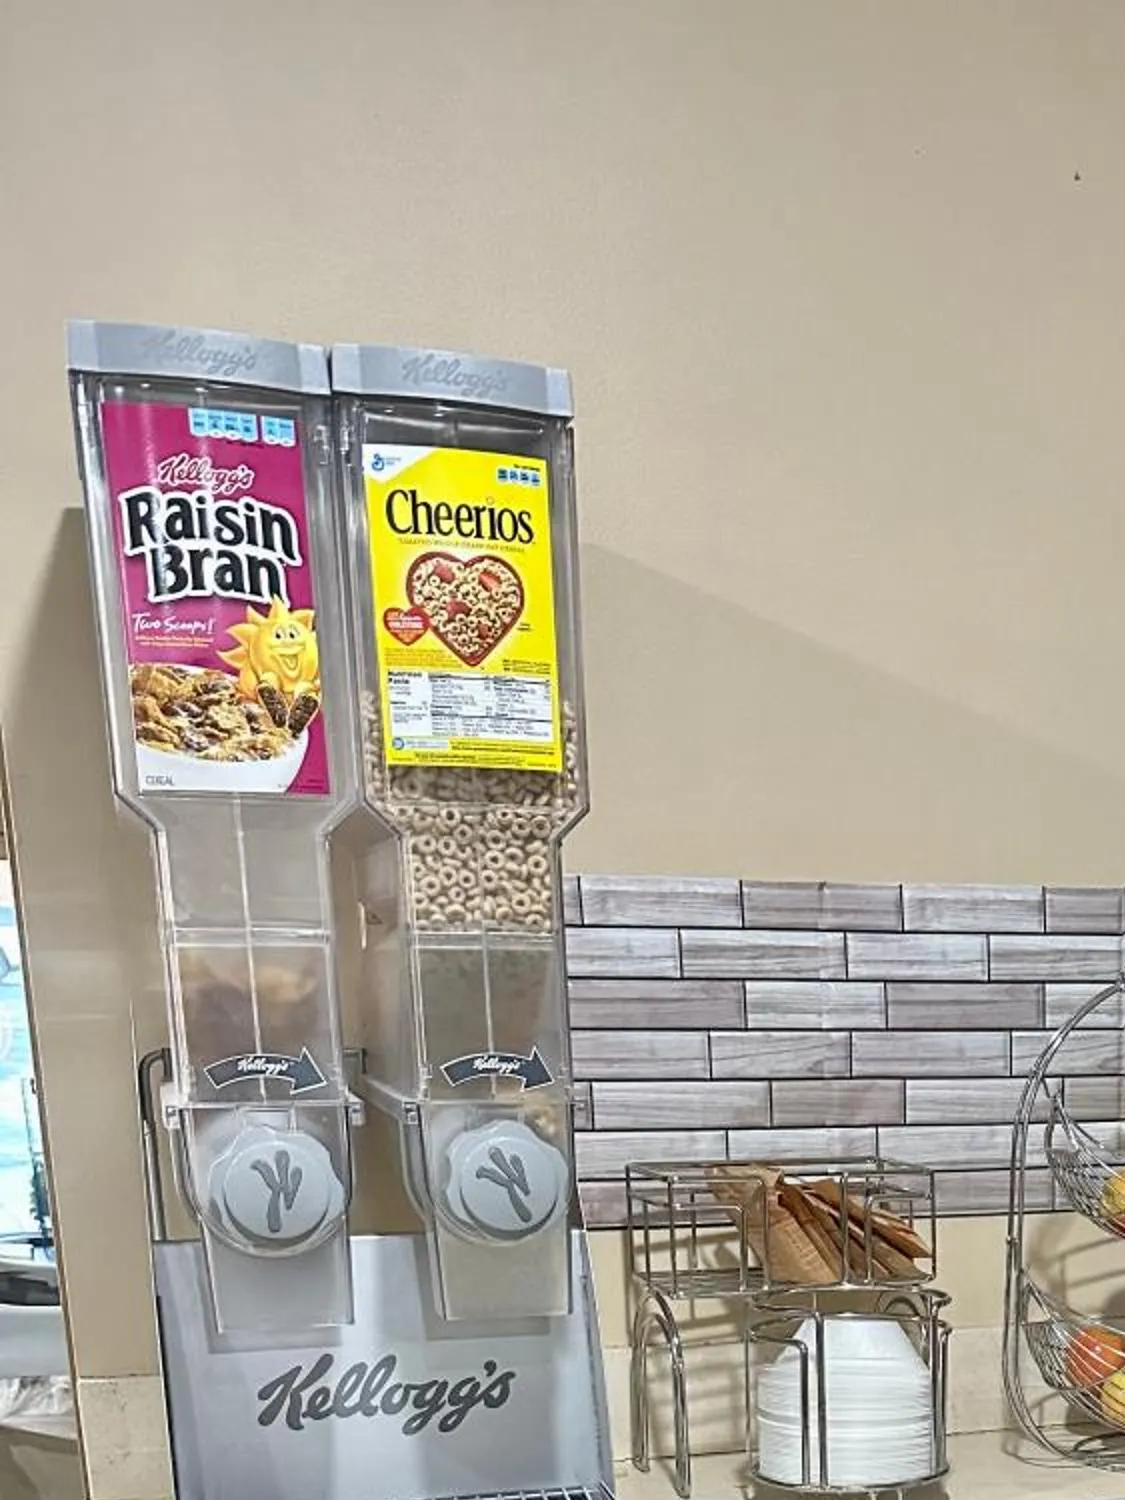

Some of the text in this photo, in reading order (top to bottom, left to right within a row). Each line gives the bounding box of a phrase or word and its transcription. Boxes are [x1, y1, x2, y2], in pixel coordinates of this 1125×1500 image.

[402, 353, 507, 398] Kellogg's
[159, 453, 254, 494] Kellogg's
[124, 491, 298, 561] Raisin
[385, 489, 534, 544] Cheerios
[150, 544, 283, 603] Bran
[132, 612, 162, 633] Two
[237, 1056, 289, 1076] Kellogg's
[473, 1055, 521, 1074] Kellogg's
[257, 1353, 517, 1435] Kellogg's
